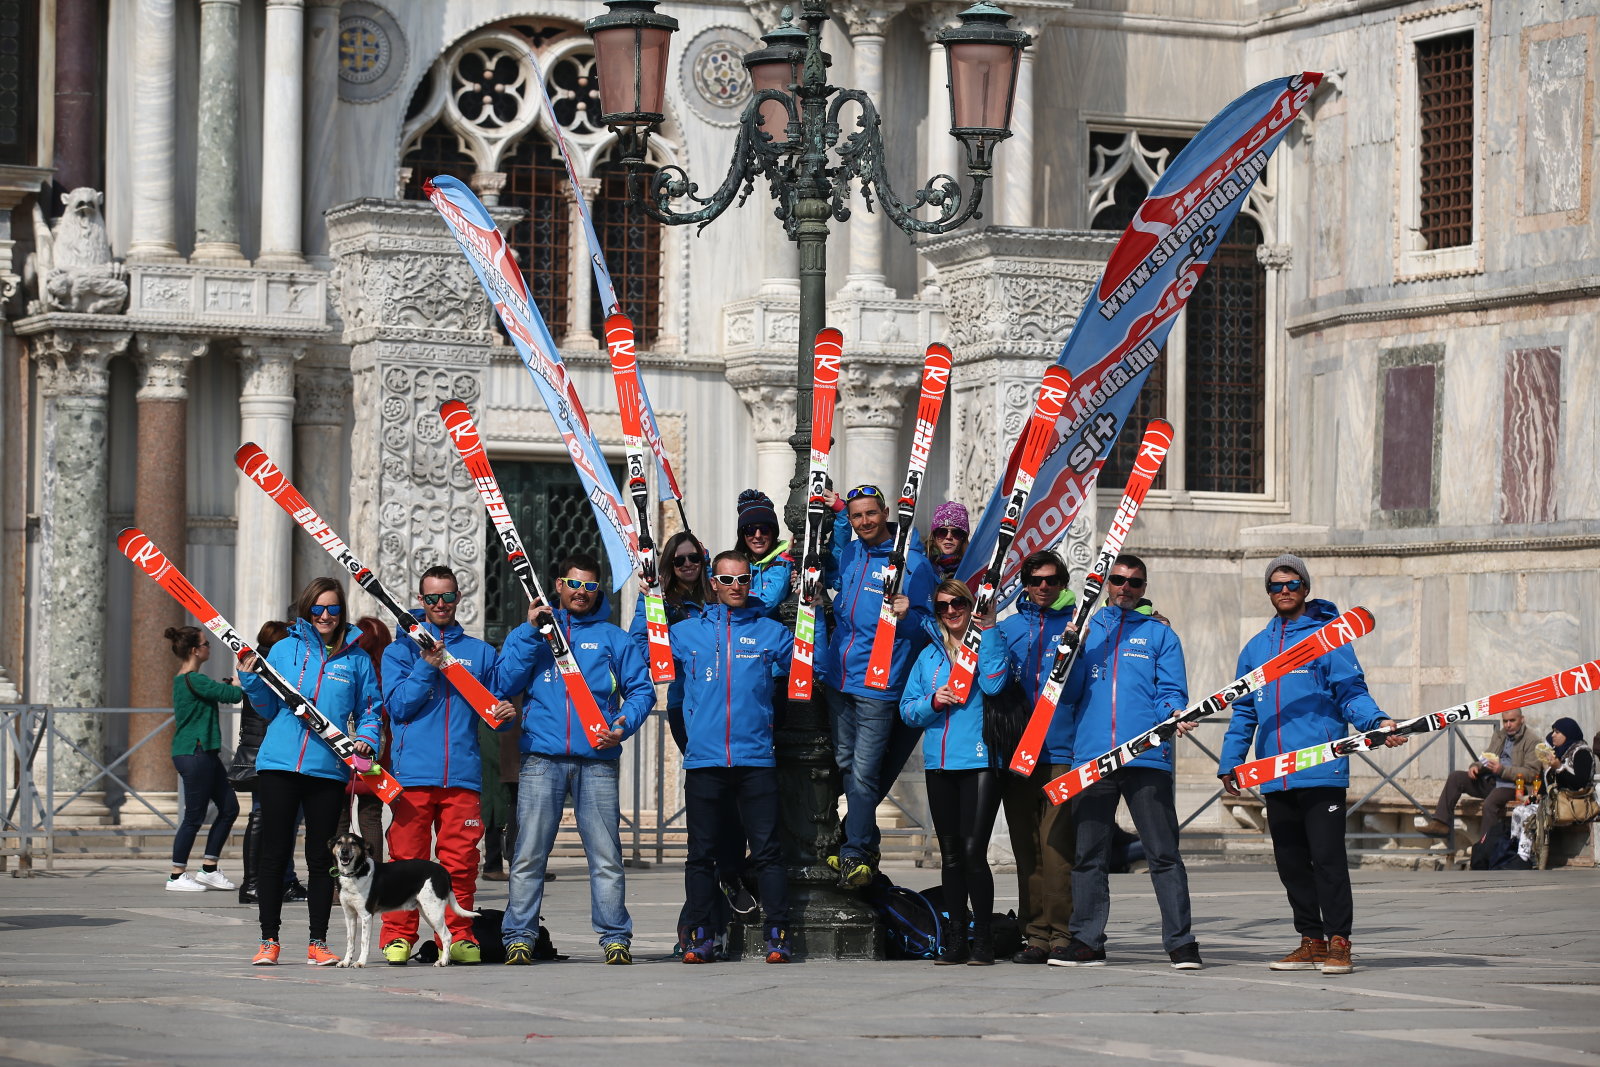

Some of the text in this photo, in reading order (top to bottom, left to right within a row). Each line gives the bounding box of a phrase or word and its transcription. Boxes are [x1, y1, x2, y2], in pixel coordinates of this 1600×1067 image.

[1099, 150, 1269, 321] www.sitanoda.hu
[908, 418, 935, 470] HERO
[475, 477, 514, 527] HERO
[1104, 495, 1139, 553] HERO
[293, 506, 347, 553] HERO
